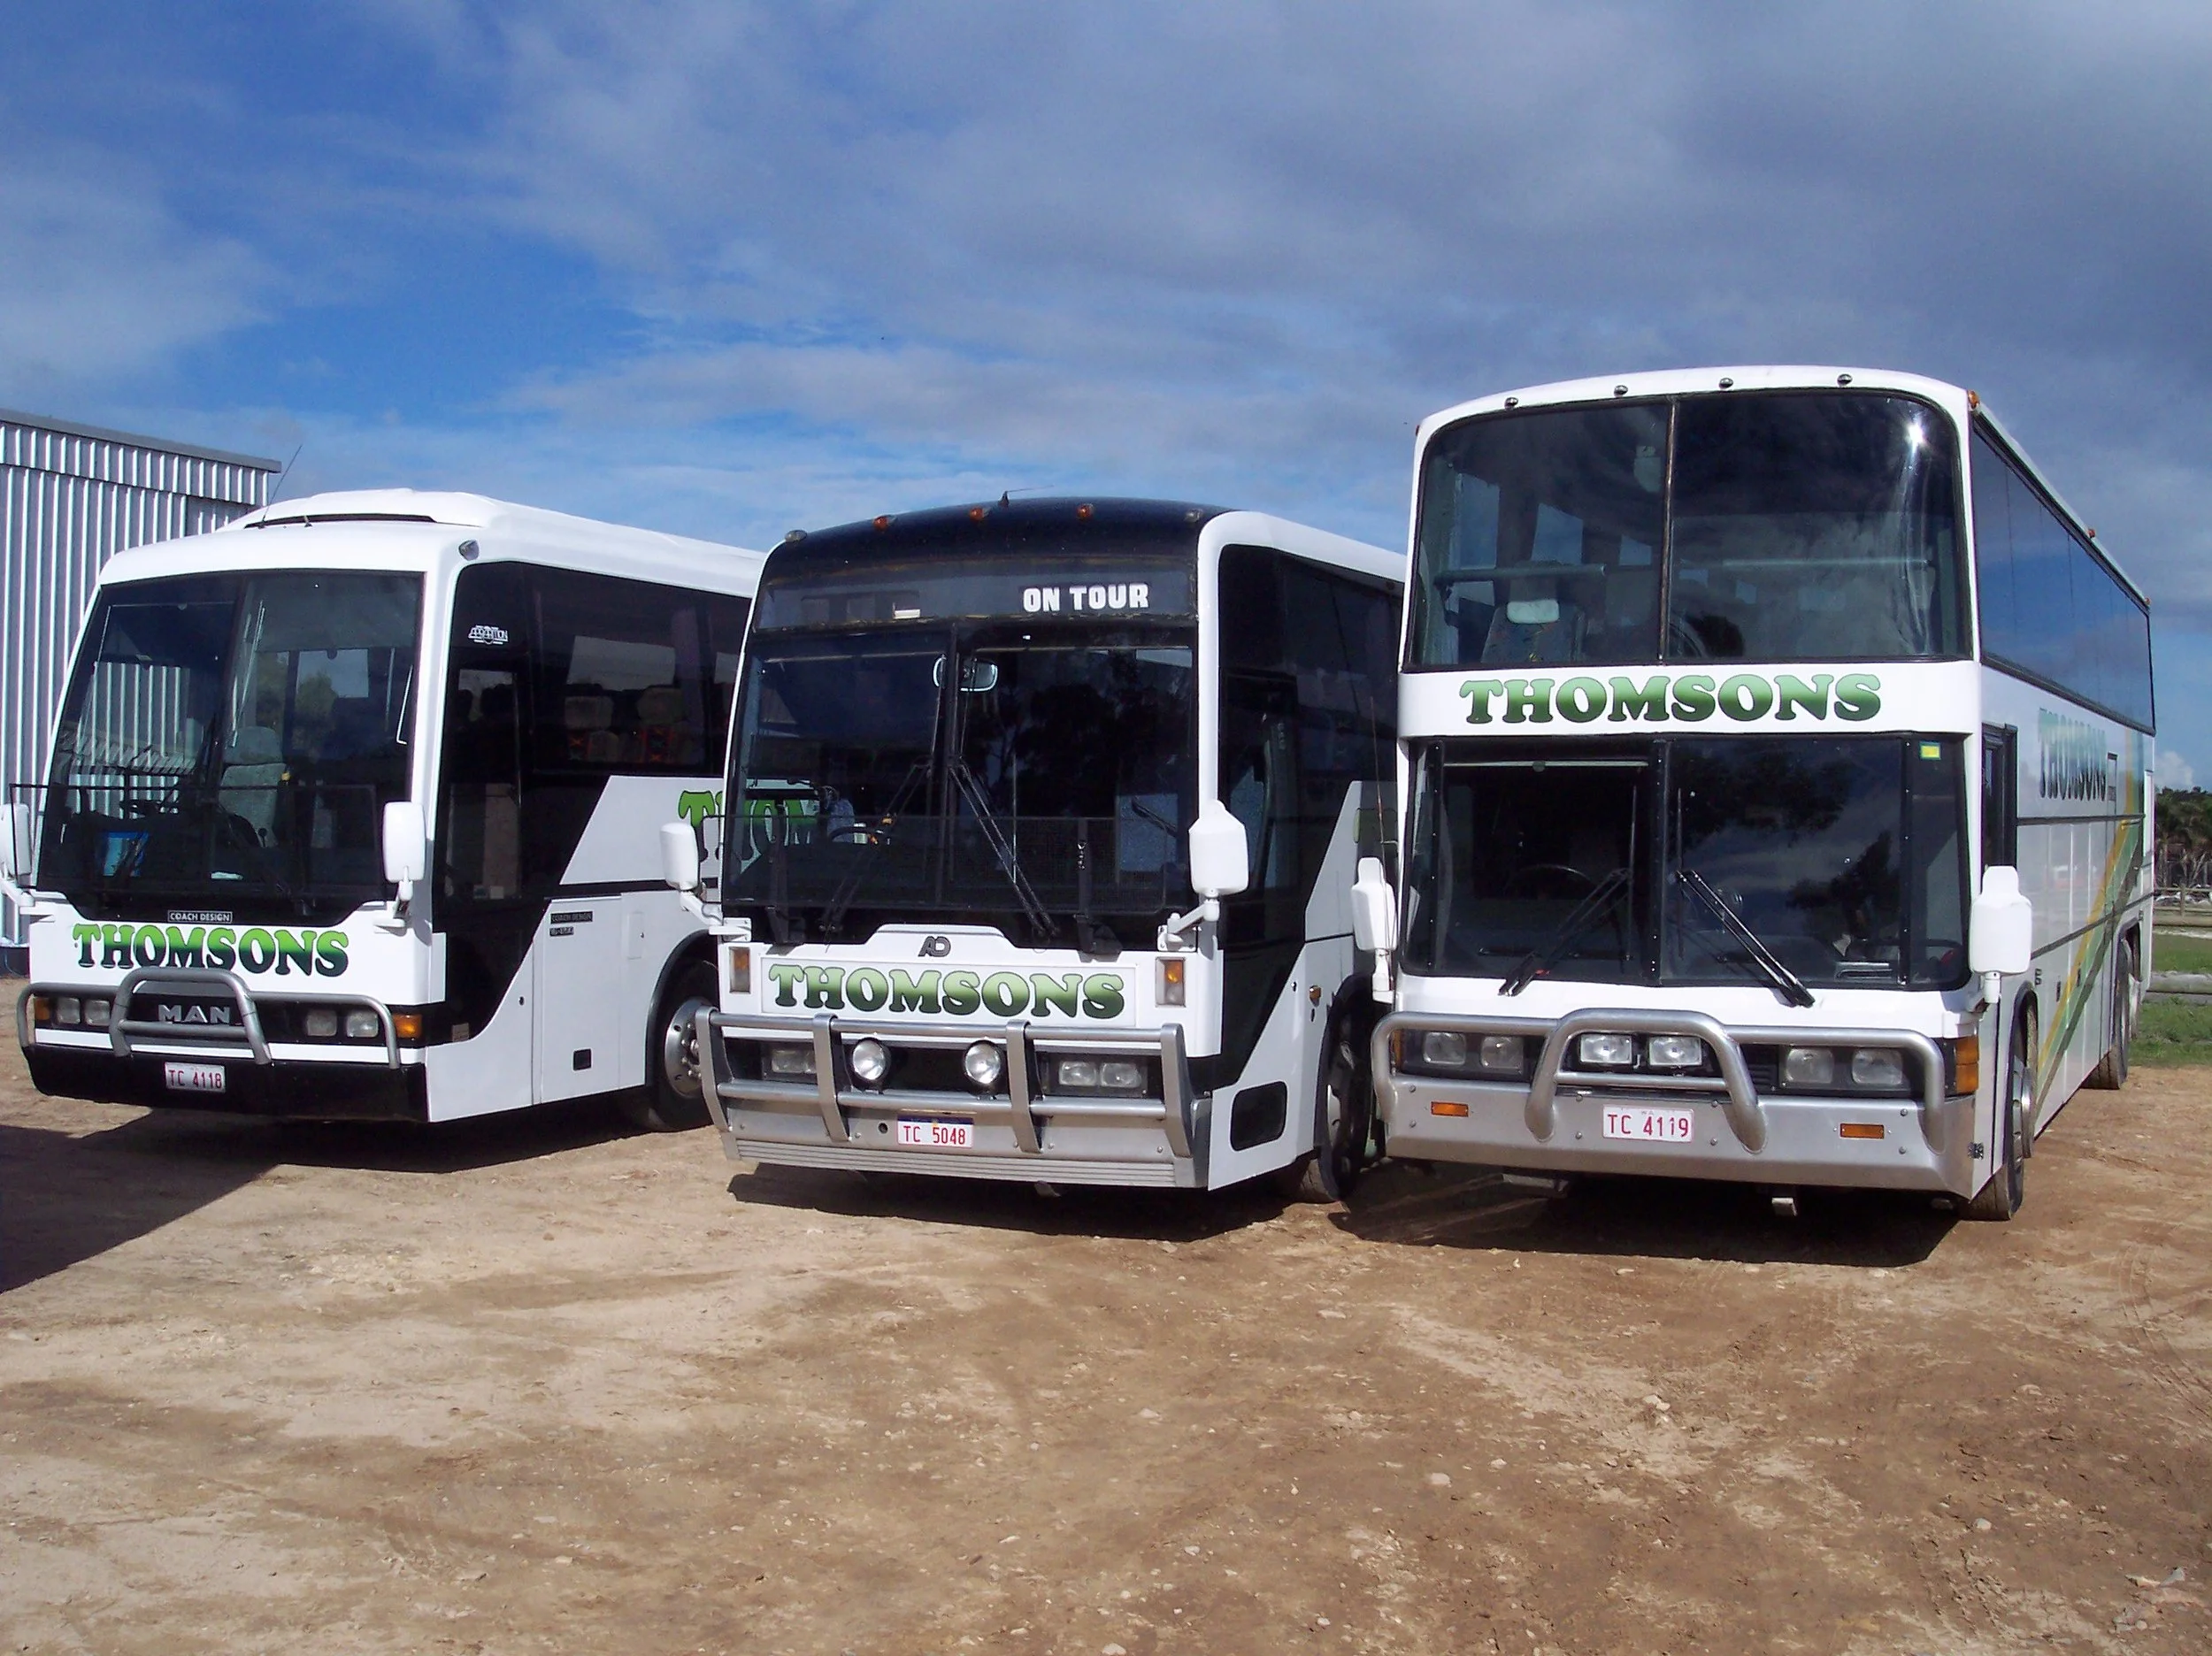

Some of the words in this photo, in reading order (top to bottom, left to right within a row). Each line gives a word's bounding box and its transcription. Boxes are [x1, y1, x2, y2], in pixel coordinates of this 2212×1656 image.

[1023, 586, 1061, 612] ON
[1069, 583, 1149, 610] TOUR
[1459, 674, 1881, 723] THOMSONS
[170, 912, 198, 921] COACH
[199, 913, 230, 922] DESIGN
[73, 924, 349, 978] THOMSONS
[768, 963, 1125, 1019] THOMSONS
[158, 1004, 231, 1024] MAN
[168, 1070, 185, 1086] TC
[193, 1071, 223, 1089] 4118
[903, 1125, 921, 1143] TC
[933, 1126, 966, 1146] 5048
[1607, 1114, 1632, 1135] TC
[1643, 1116, 1689, 1138] 4119
